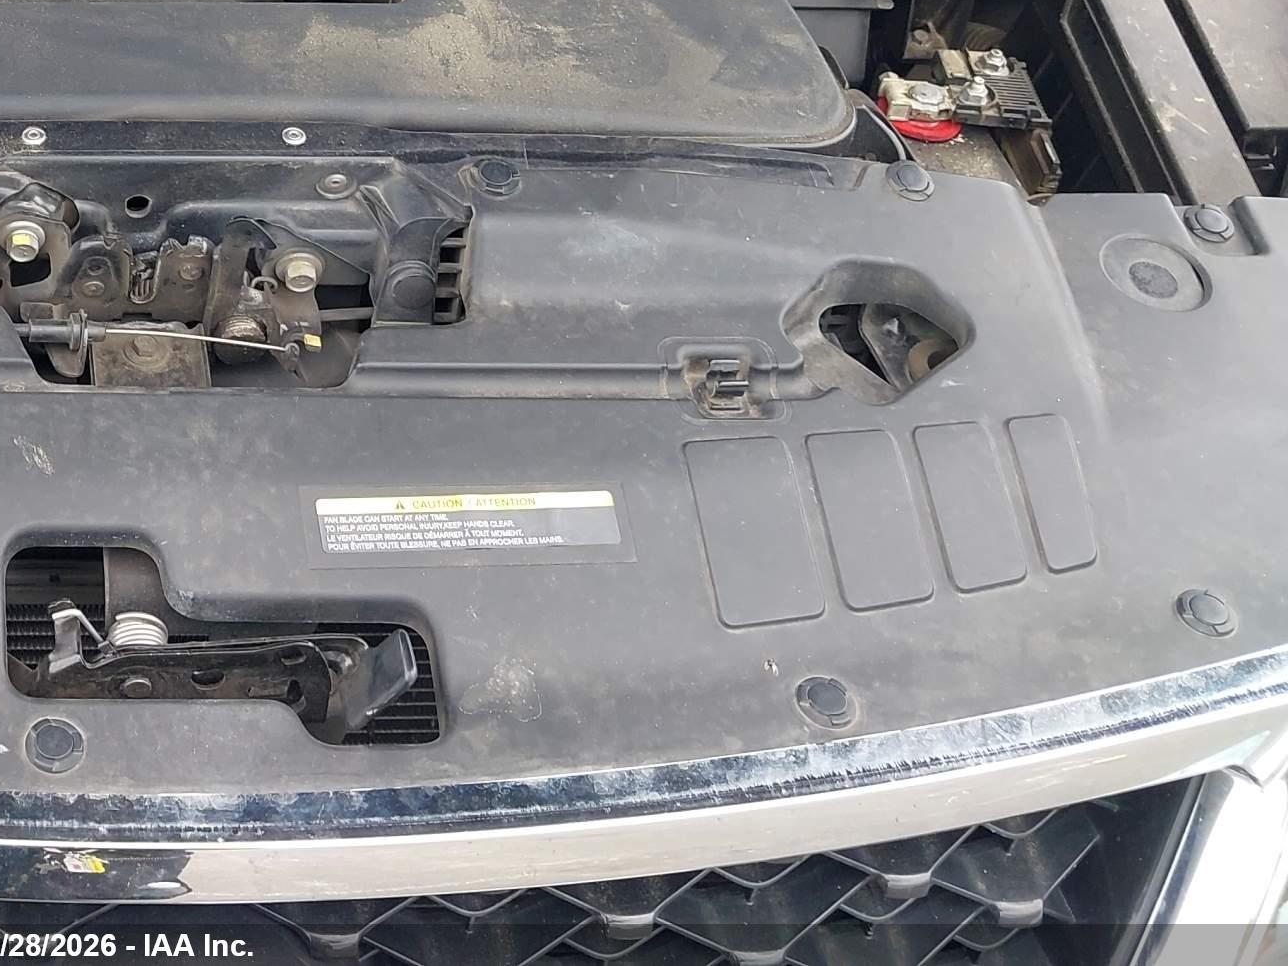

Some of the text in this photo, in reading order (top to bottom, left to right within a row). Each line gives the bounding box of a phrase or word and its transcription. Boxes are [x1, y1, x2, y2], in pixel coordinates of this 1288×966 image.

[412, 500, 463, 510] CAUTION
[476, 498, 536, 507] ATTENTION
[380, 523, 418, 531] PERSONAL
[337, 534, 383, 542] VENTILATEUR
[465, 529, 471, 537] À
[350, 542, 374, 550] ÉVITER
[480, 538, 524, 546] APPROCHER
